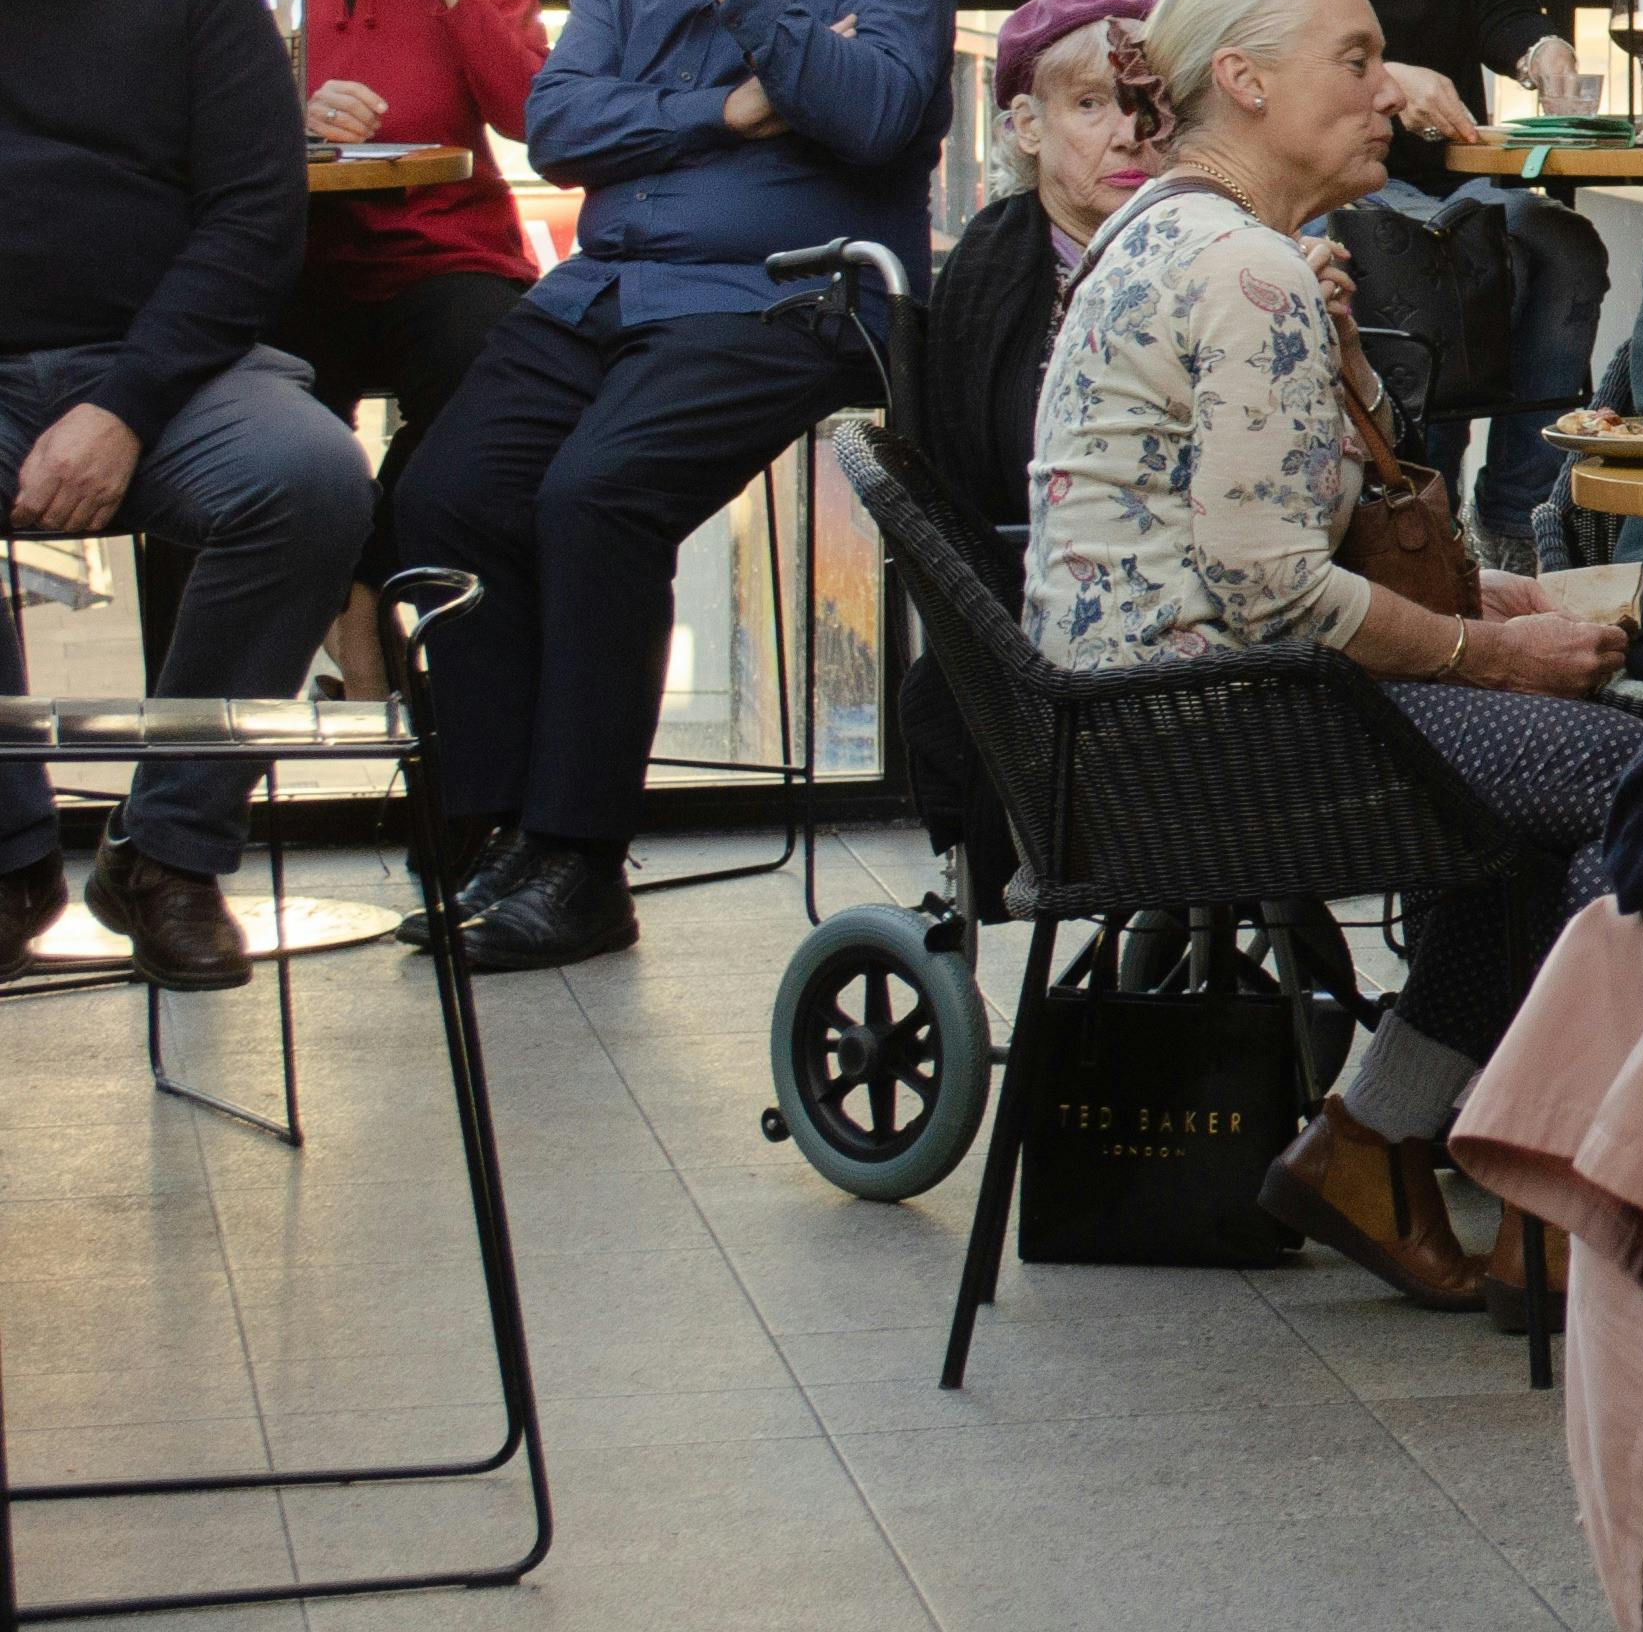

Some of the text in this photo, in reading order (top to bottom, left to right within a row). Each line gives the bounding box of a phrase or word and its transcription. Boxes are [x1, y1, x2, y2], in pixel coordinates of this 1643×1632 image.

[1058, 1103, 1243, 1134] TED BAKER
[1102, 1143, 1187, 1158] LONDON
